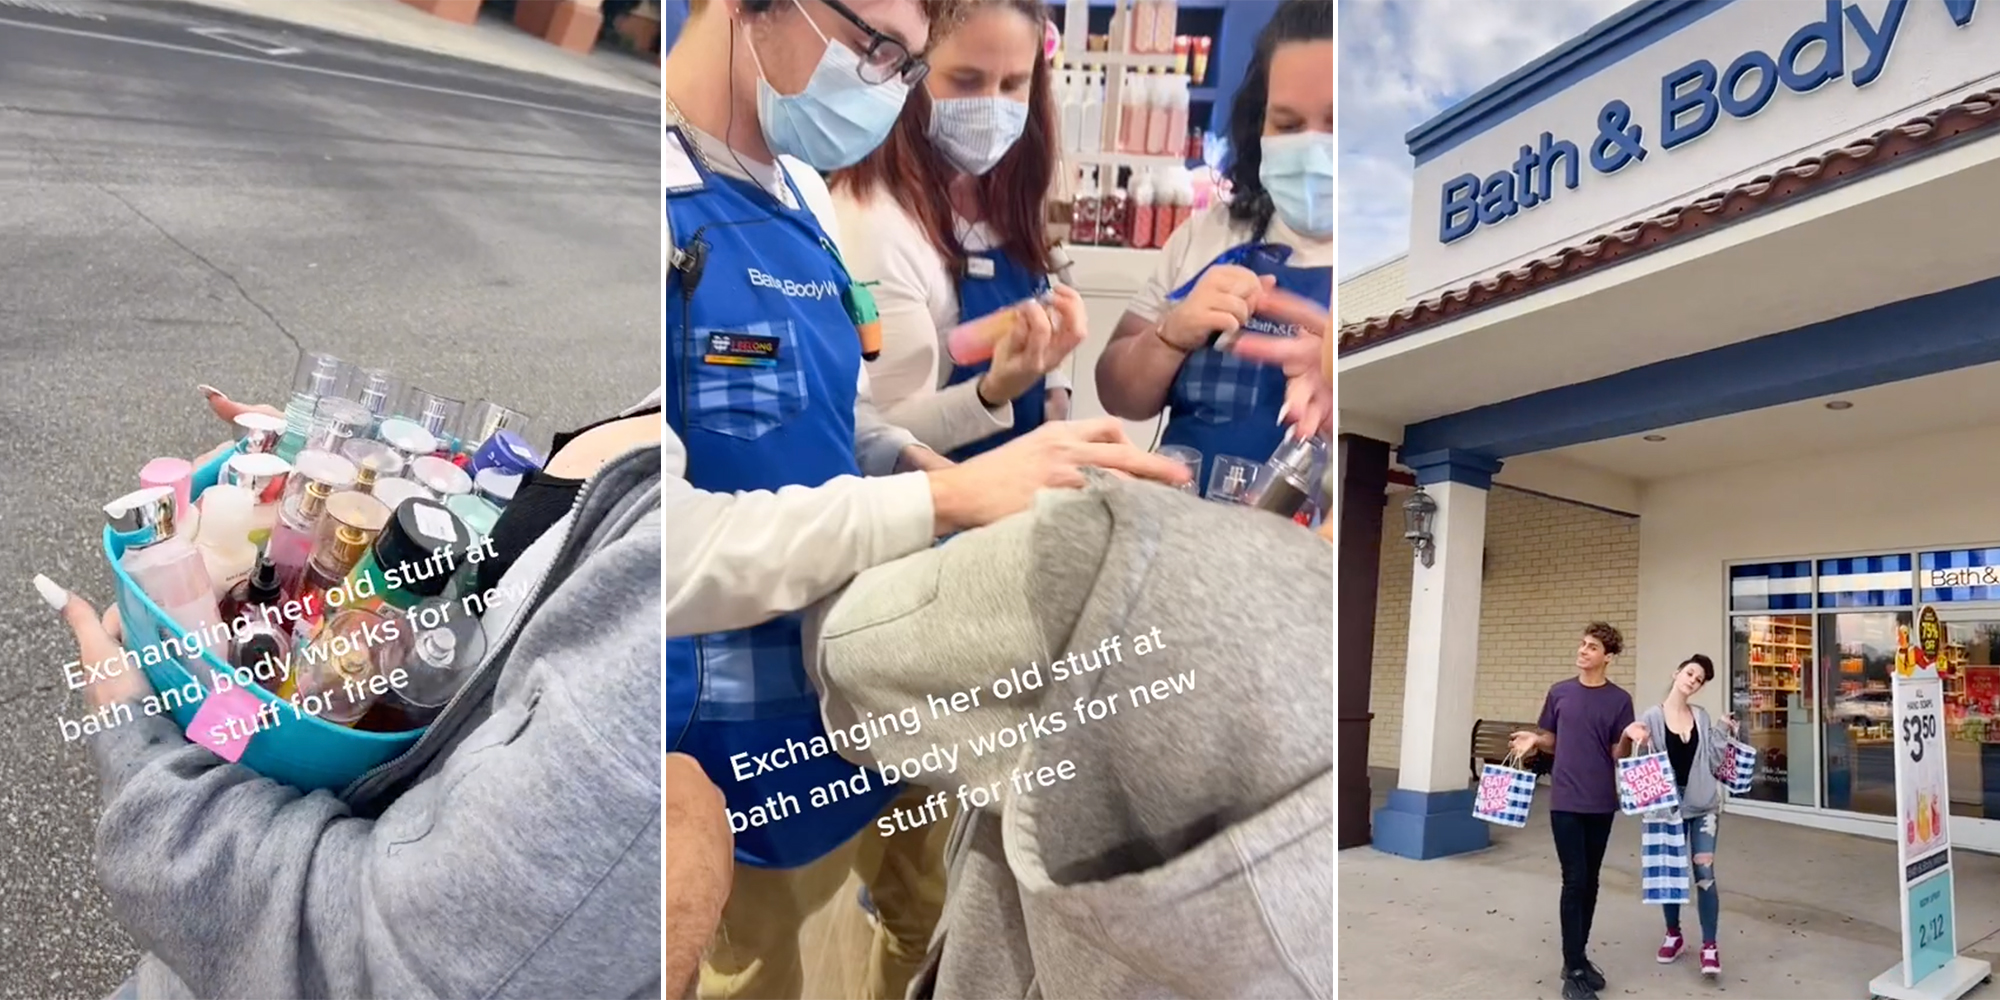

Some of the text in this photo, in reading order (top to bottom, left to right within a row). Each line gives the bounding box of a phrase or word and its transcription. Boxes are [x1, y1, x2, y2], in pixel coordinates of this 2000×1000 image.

[1438, 0, 1906, 245] Bath & Body
[1932, 566, 2000, 586] Bath &
[1626, 759, 1658, 782] BATH
[1635, 770, 1665, 791] BODY
[1919, 924, 1927, 949] 2
